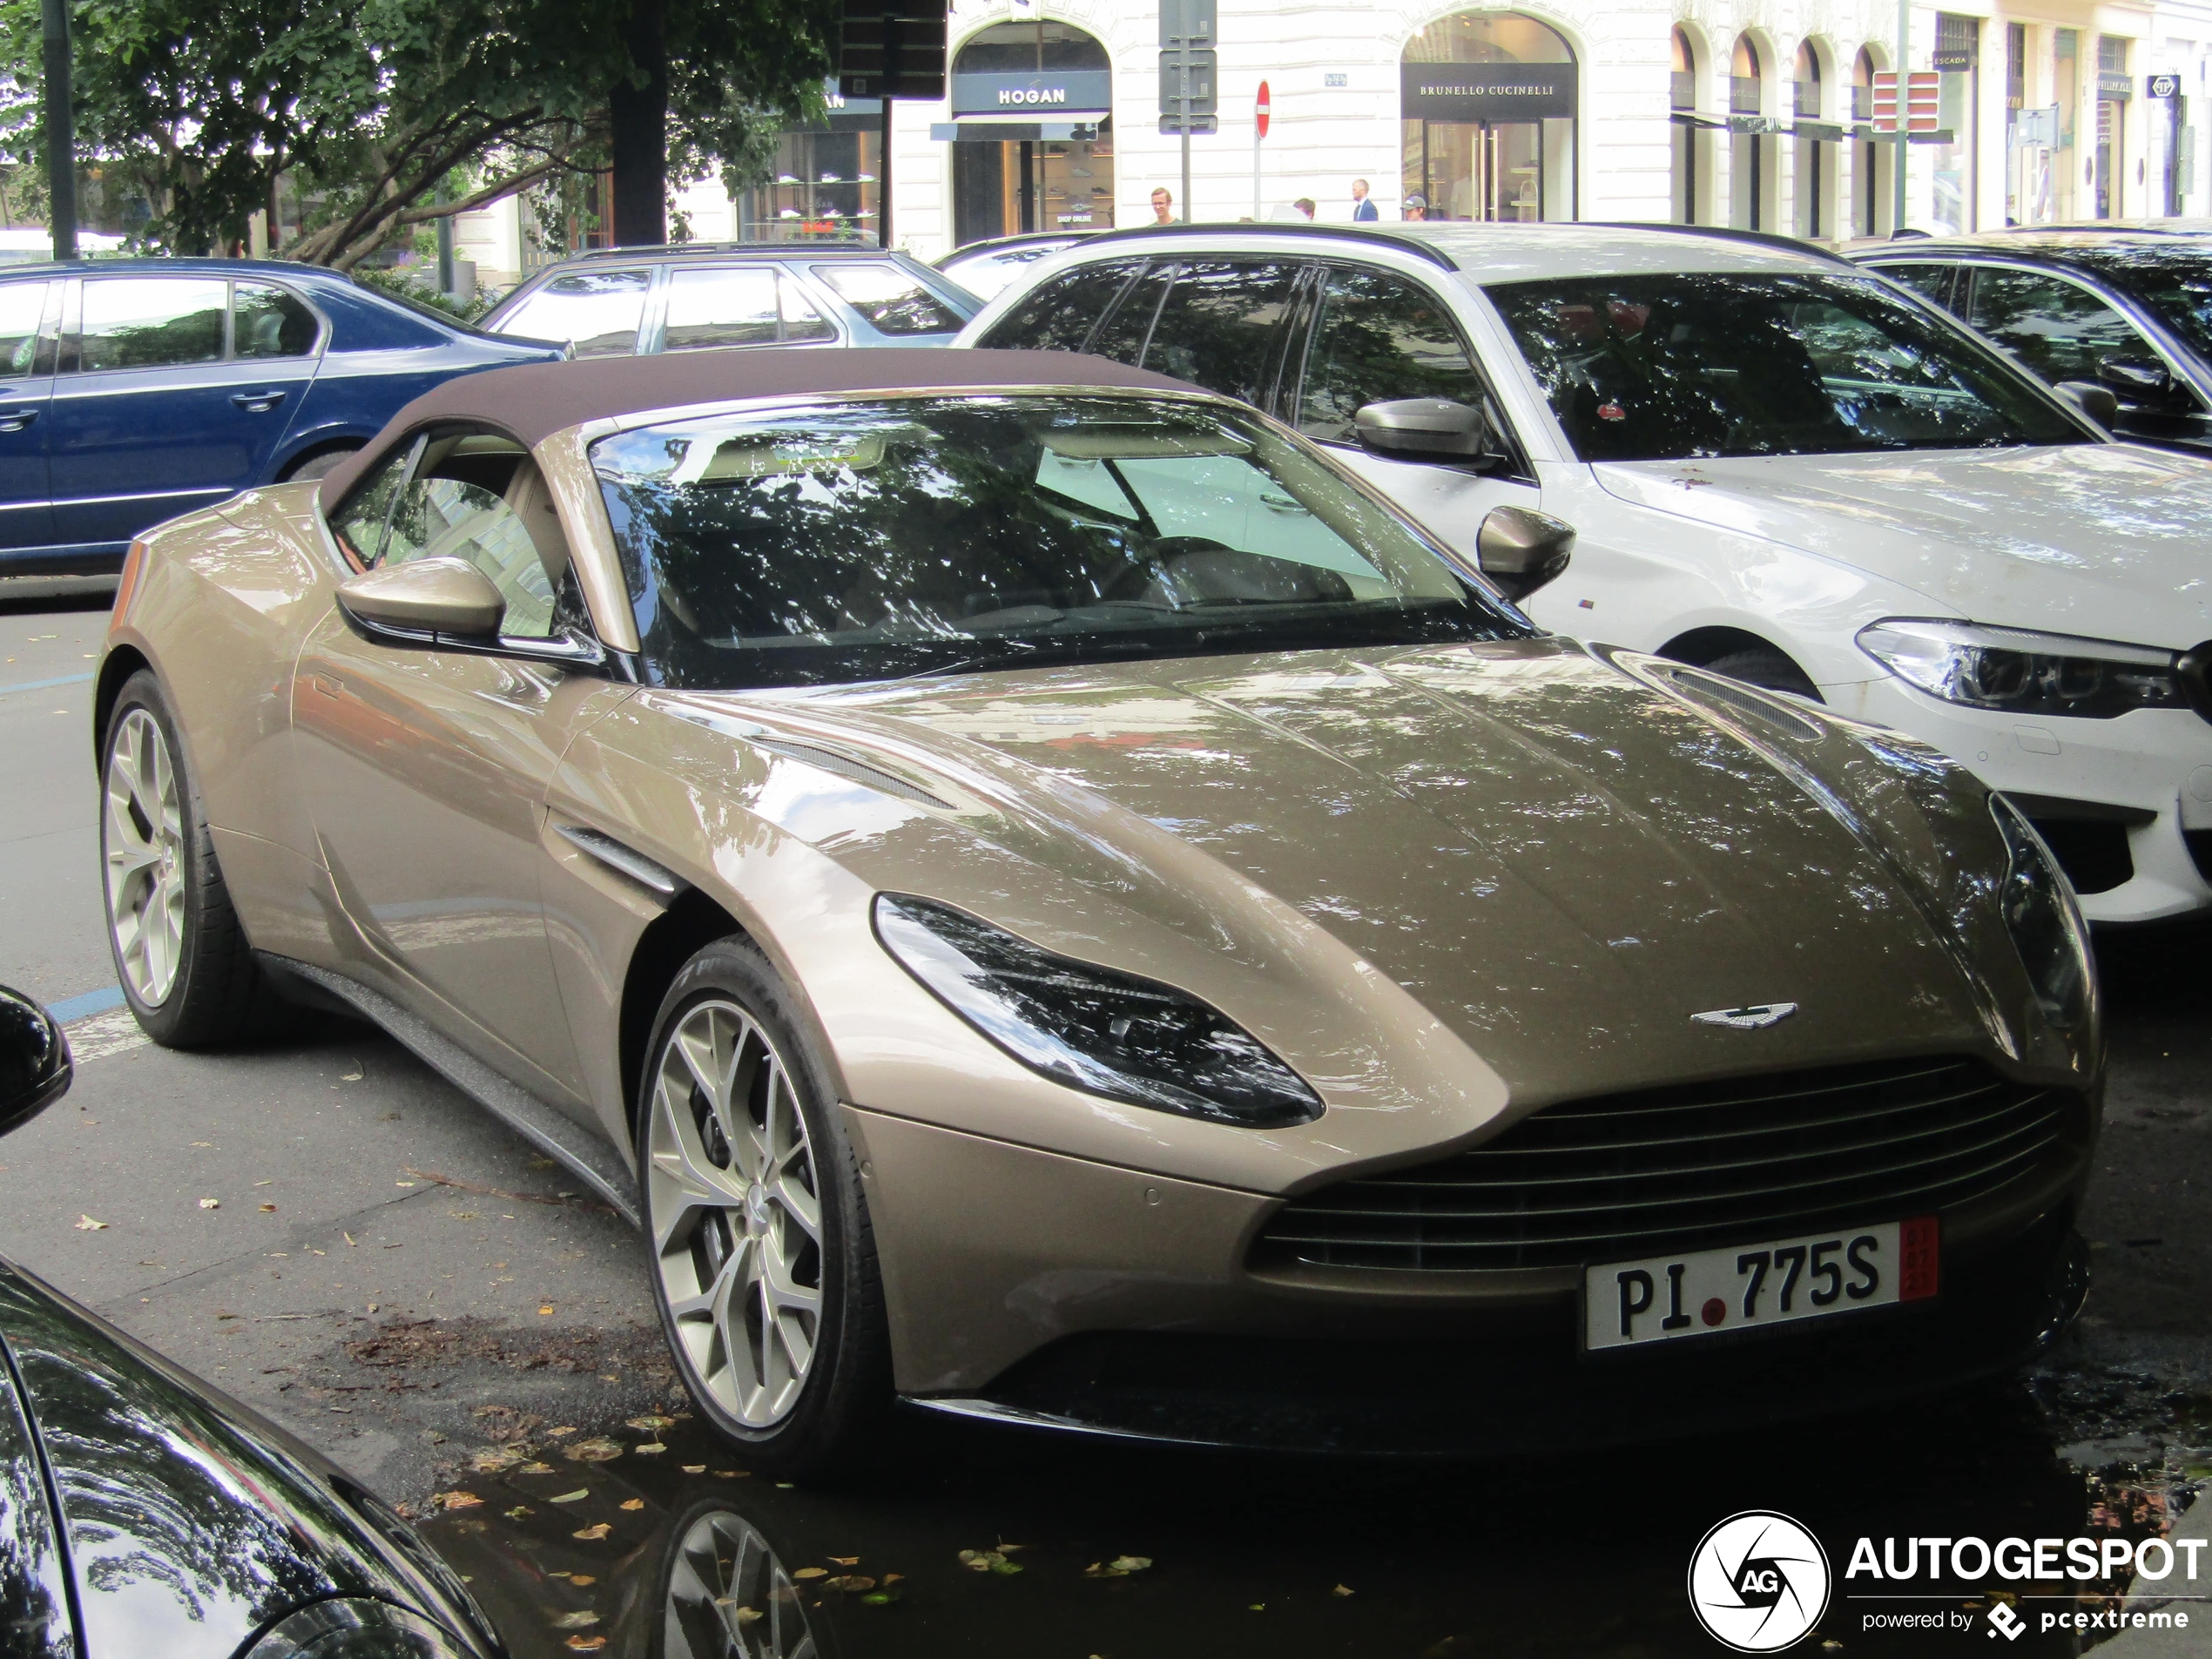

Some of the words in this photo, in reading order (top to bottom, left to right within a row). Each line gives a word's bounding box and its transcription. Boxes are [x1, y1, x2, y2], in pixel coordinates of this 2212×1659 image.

[1934, 57, 1966, 65] ESCADA
[1420, 85, 1485, 96] BRUNELLO
[1488, 85, 1554, 96] CUCINELLI
[999, 90, 1065, 105] HOGAN
[1073, 214, 1092, 223] ONLINE
[1615, 1264, 1691, 1337] PI
[1737, 1235, 1879, 1318] 775S
